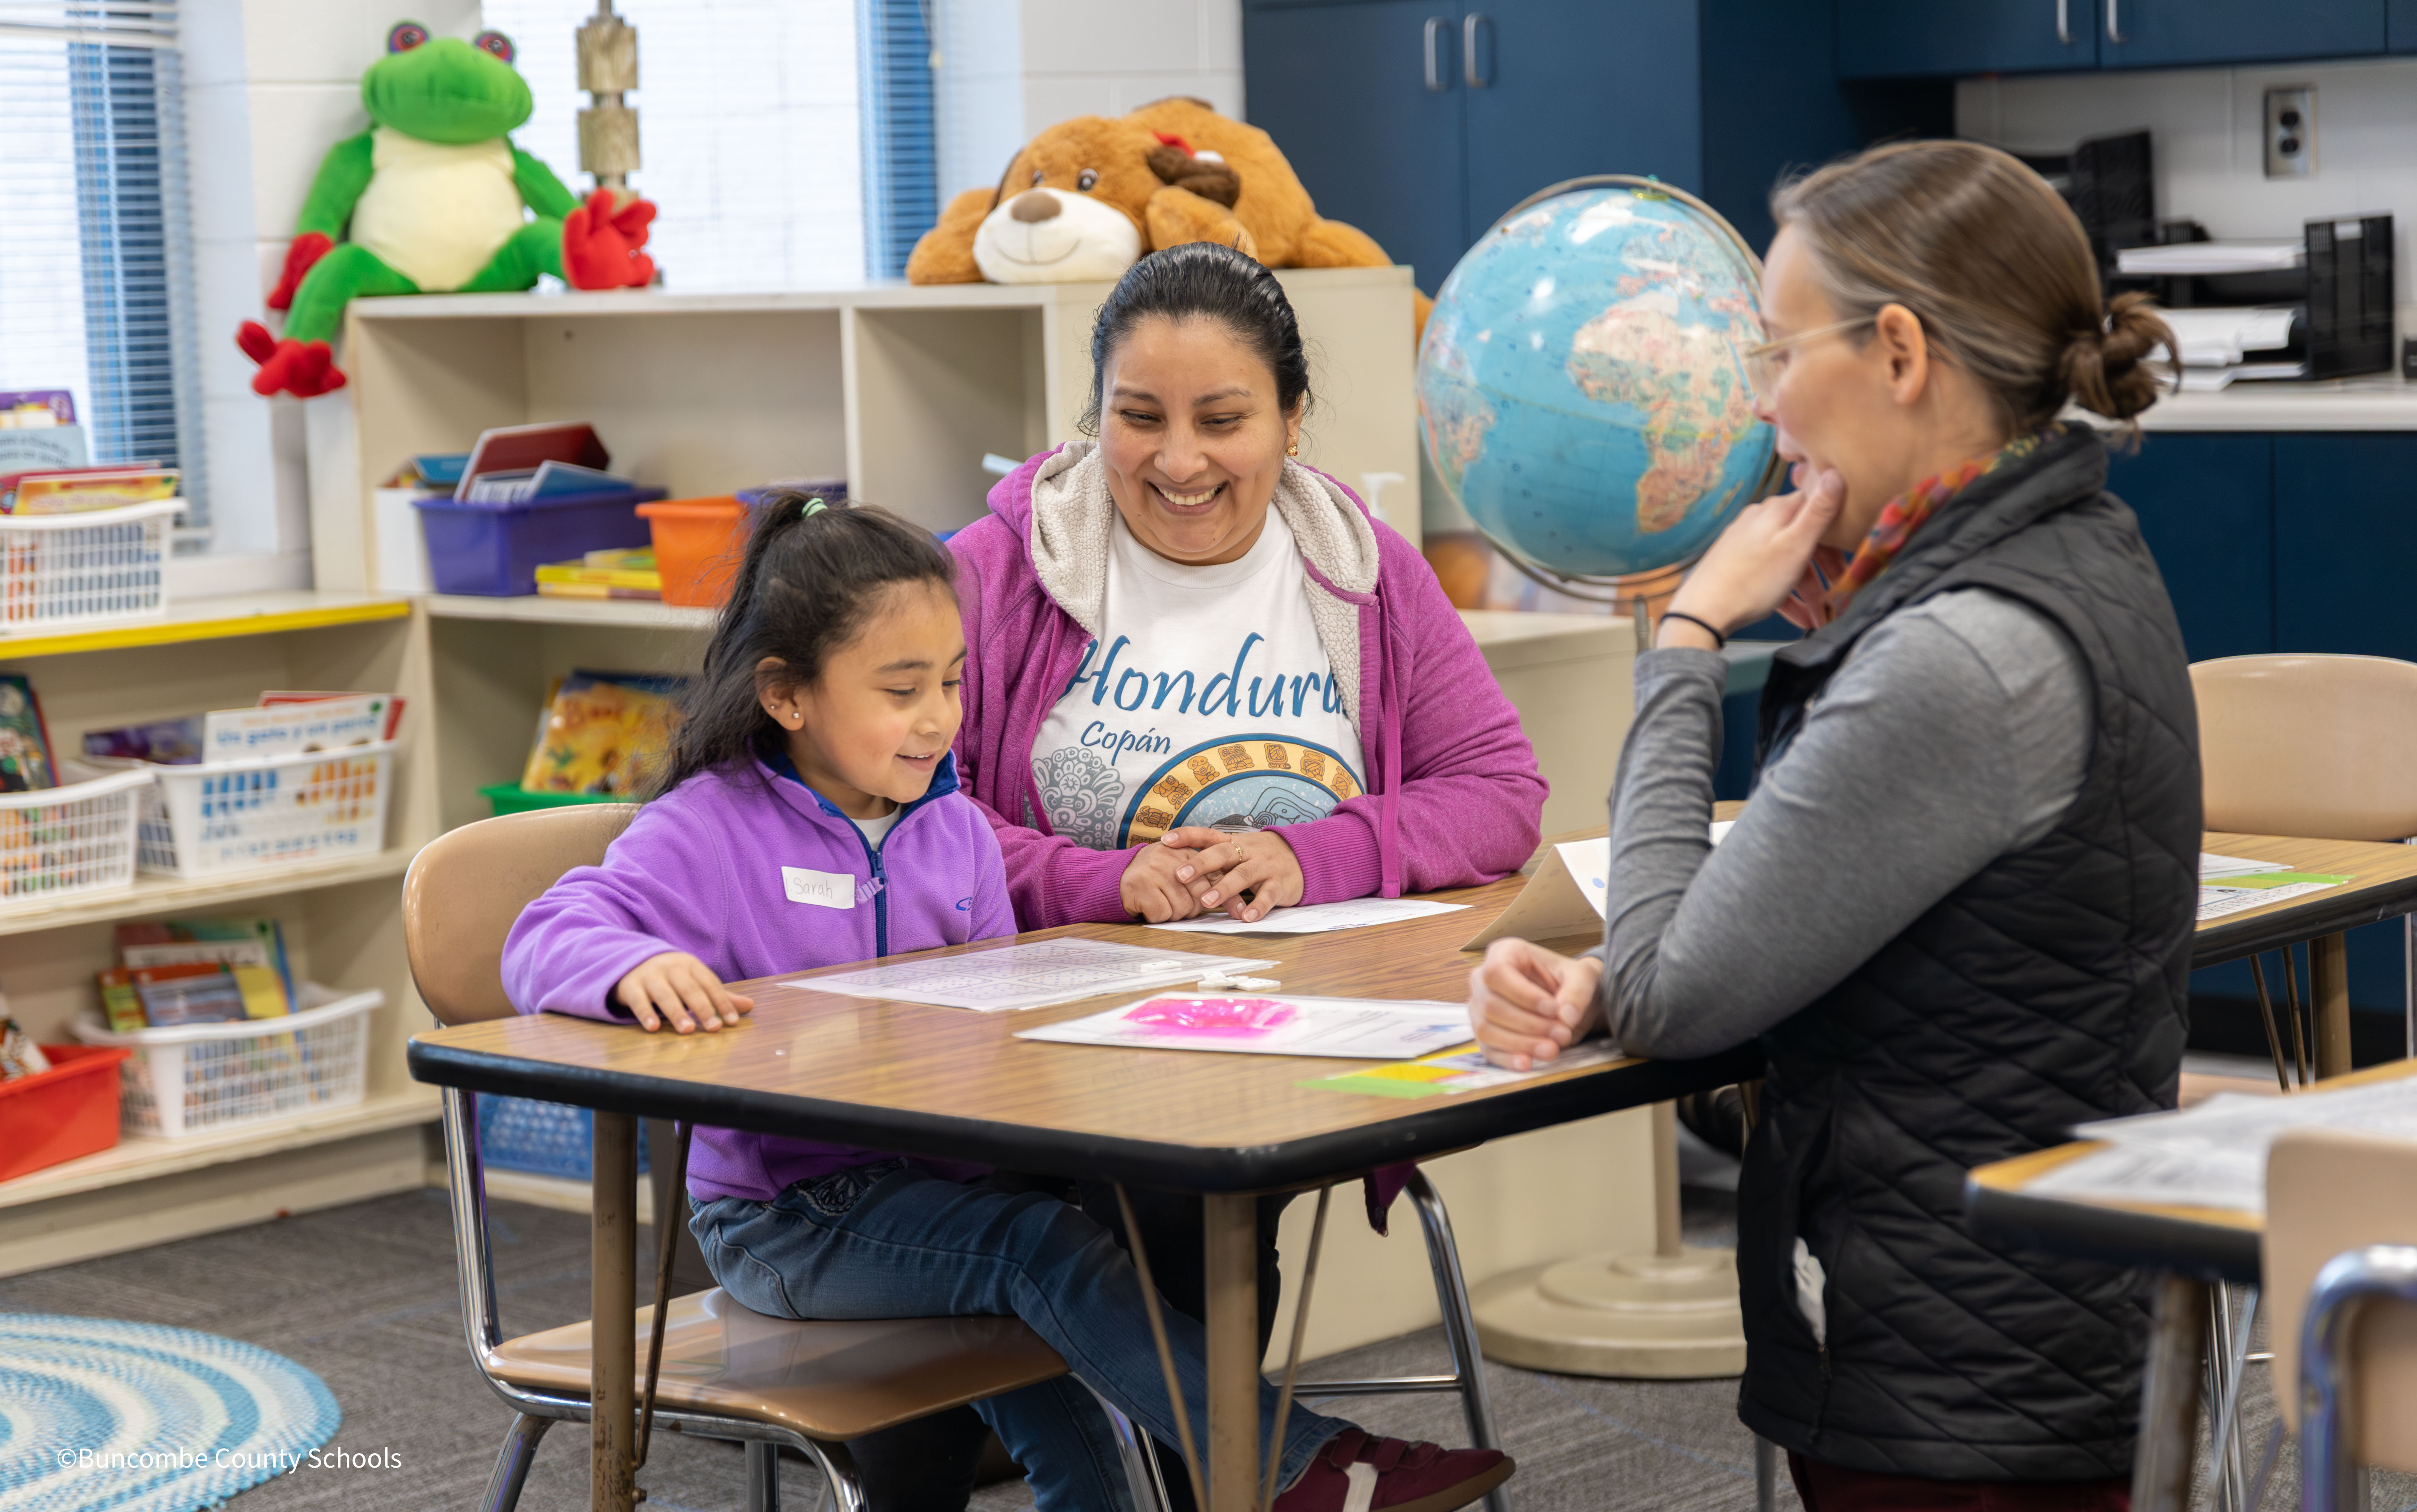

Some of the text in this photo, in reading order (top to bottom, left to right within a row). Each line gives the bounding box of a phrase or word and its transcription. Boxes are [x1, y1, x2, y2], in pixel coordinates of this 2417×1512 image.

[1056, 632, 1347, 717] Hondura
[1080, 720, 1171, 766] Copán
[793, 877, 832, 899] Sarah
